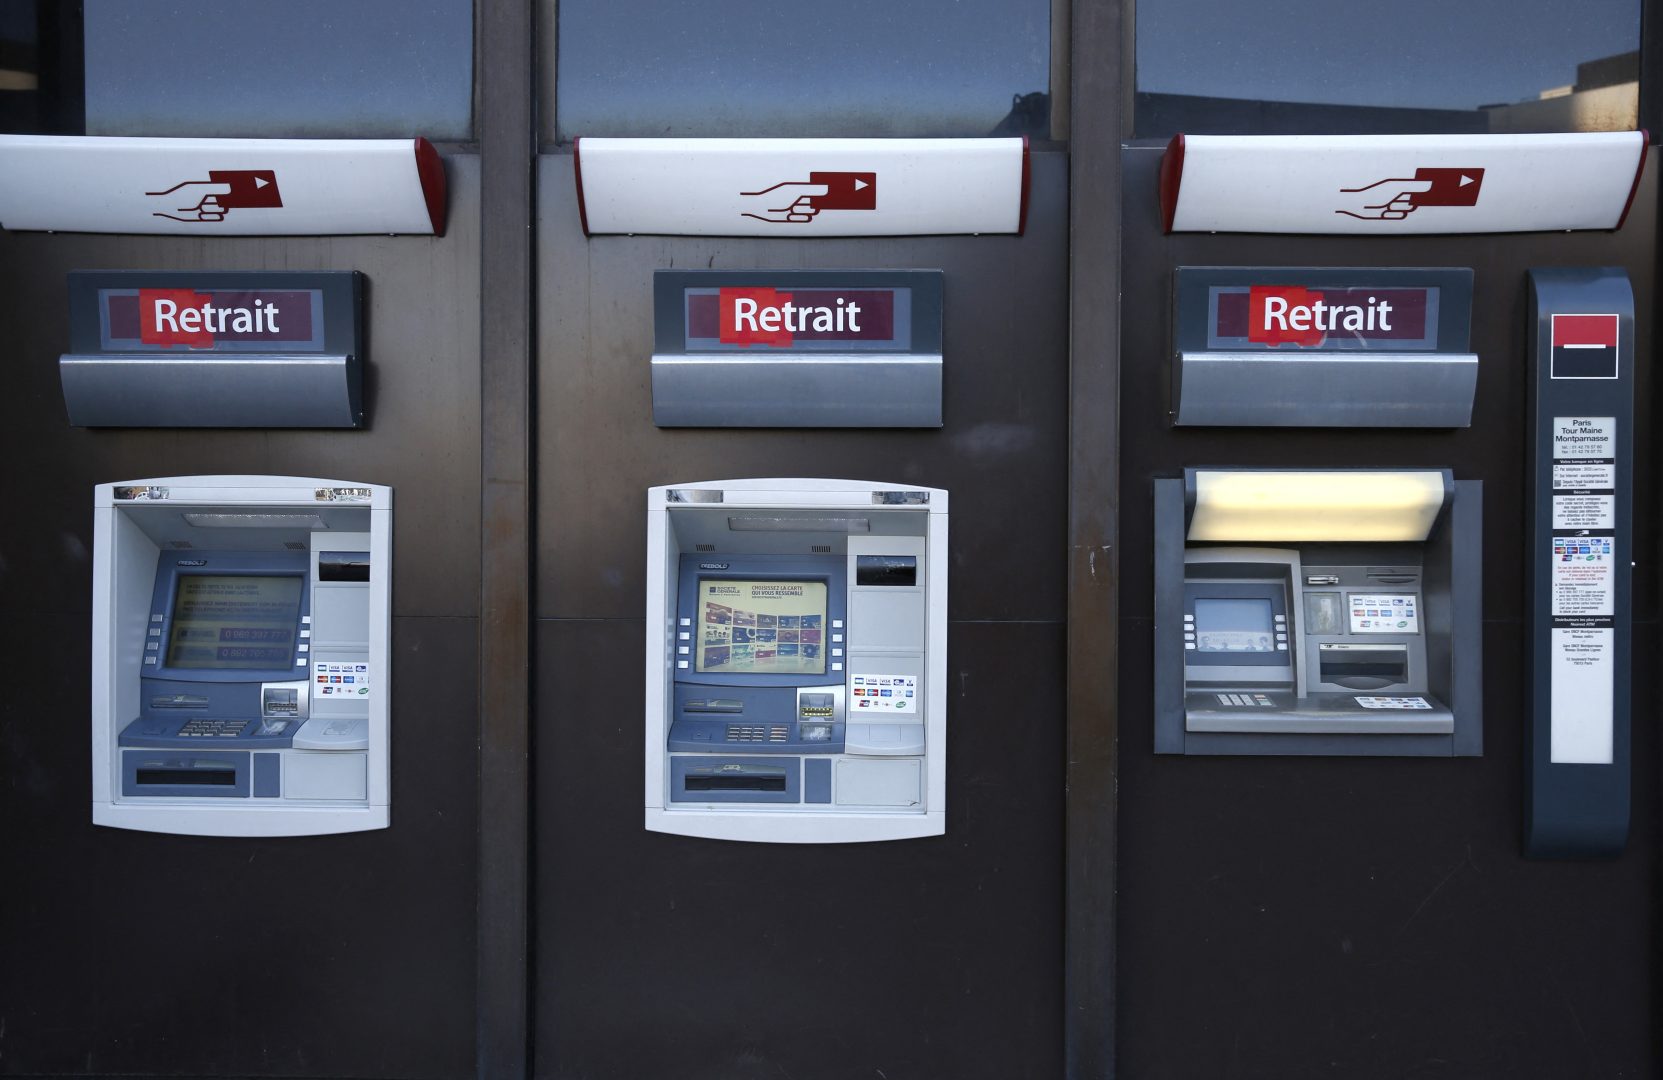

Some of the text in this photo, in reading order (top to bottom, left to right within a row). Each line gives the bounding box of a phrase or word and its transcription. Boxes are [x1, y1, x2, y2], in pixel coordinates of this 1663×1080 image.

[155, 299, 280, 334] Retrait
[735, 297, 861, 333] Retrait
[1264, 296, 1393, 332] Retrait
